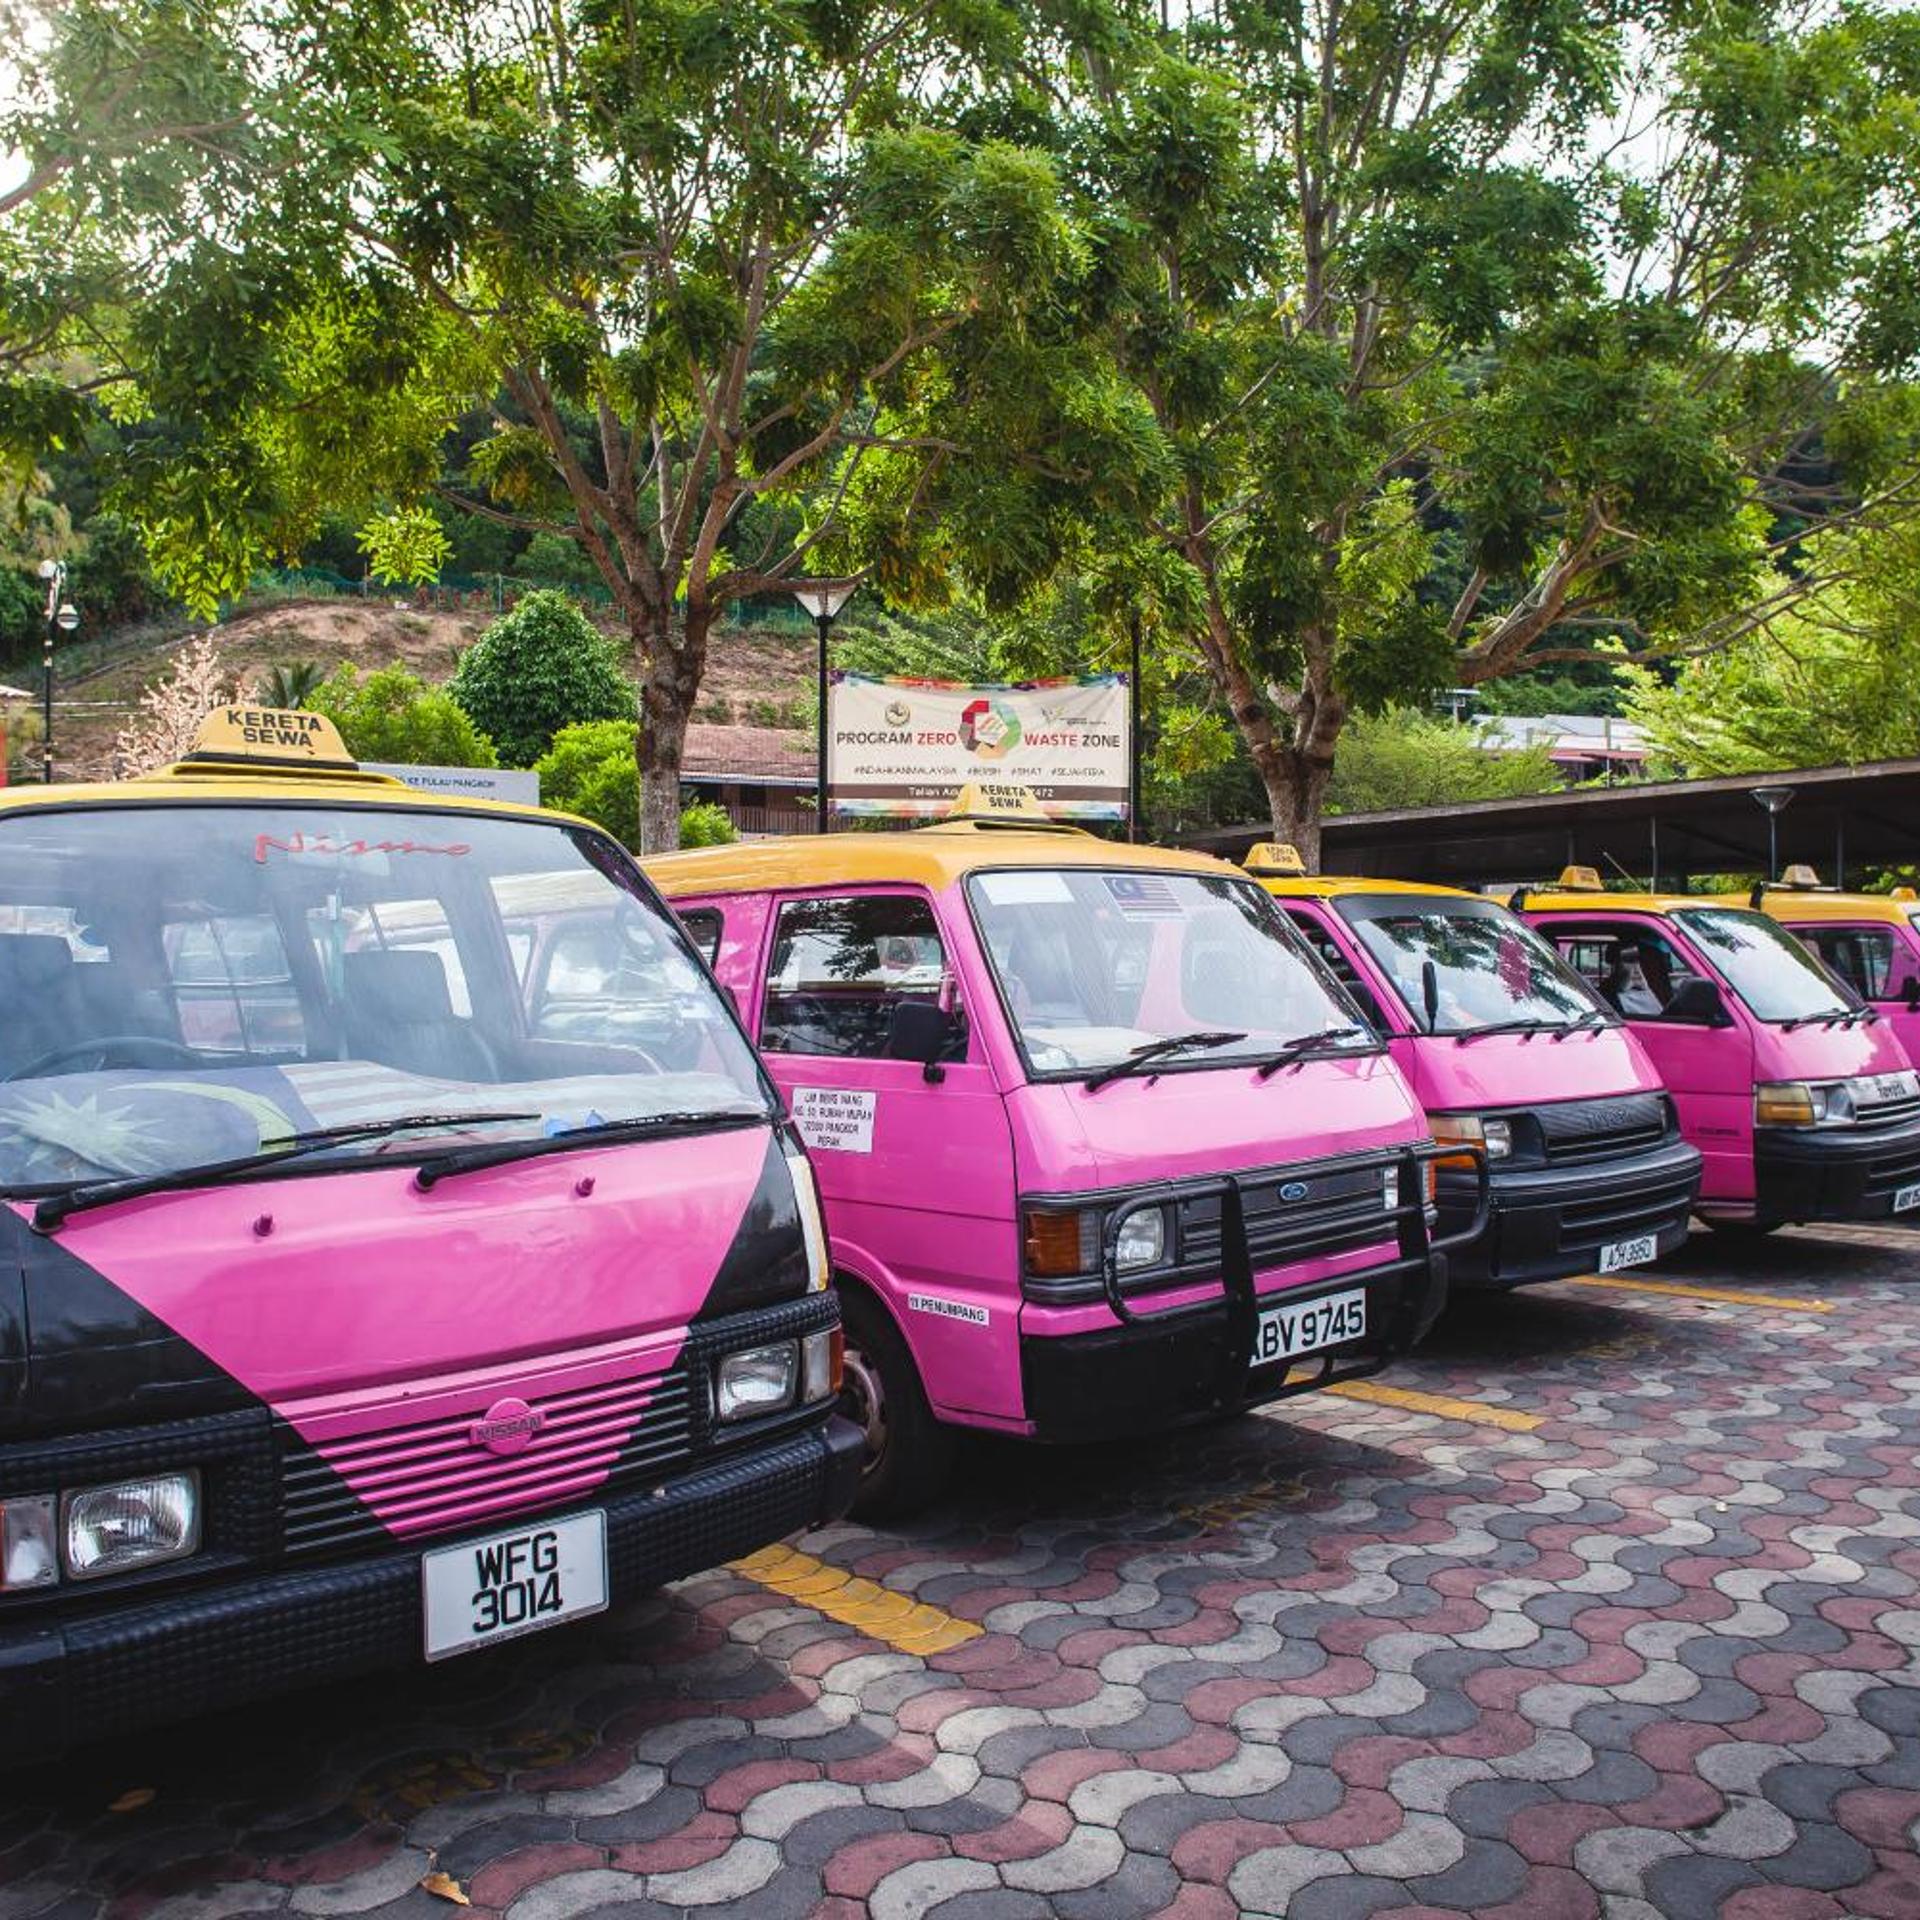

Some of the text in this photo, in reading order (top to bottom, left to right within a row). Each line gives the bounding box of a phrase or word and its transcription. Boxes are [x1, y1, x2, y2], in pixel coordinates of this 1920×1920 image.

[227, 710, 322, 732] KERETA
[243, 727, 313, 747] SEWA
[836, 732, 1120, 748] PROGRAM ZERO WASTE ZONE
[979, 784, 1027, 797] KERETA
[989, 797, 1023, 808] SEWA
[1252, 1299, 1363, 1360] BV 9745
[475, 1531, 558, 1589] WFG
[471, 1572, 563, 1633] 3014
